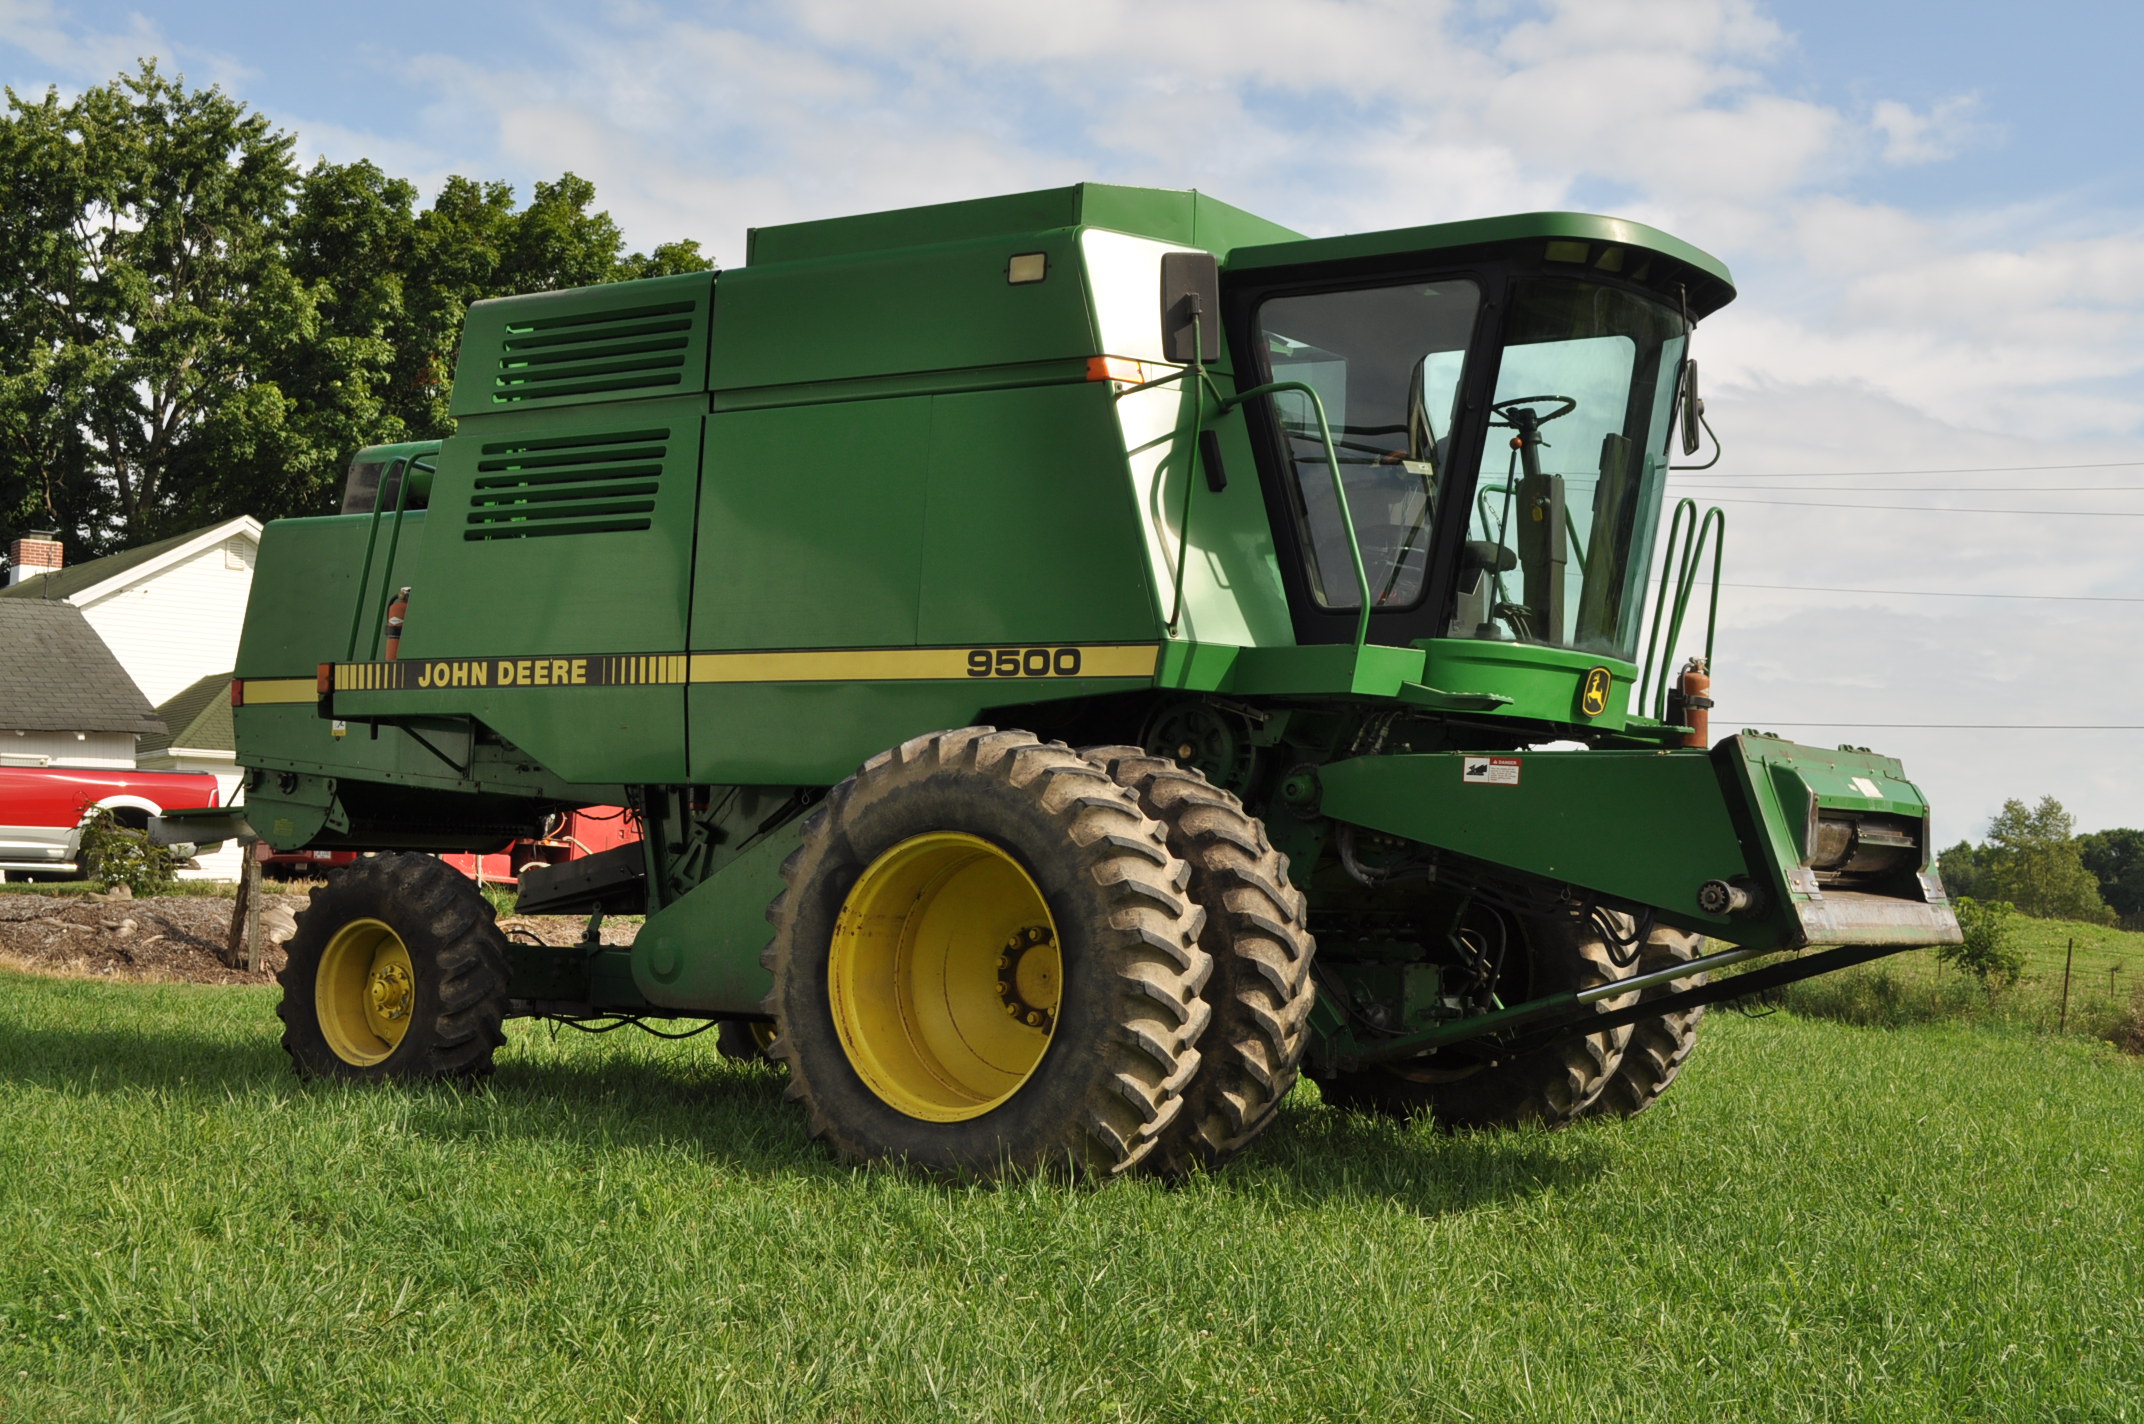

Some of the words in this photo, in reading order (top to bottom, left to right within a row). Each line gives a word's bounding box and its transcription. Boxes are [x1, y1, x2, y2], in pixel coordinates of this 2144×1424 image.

[418, 661, 488, 688] JOHN
[497, 659, 587, 686] DEERE
[966, 648, 1081, 677] 9500
